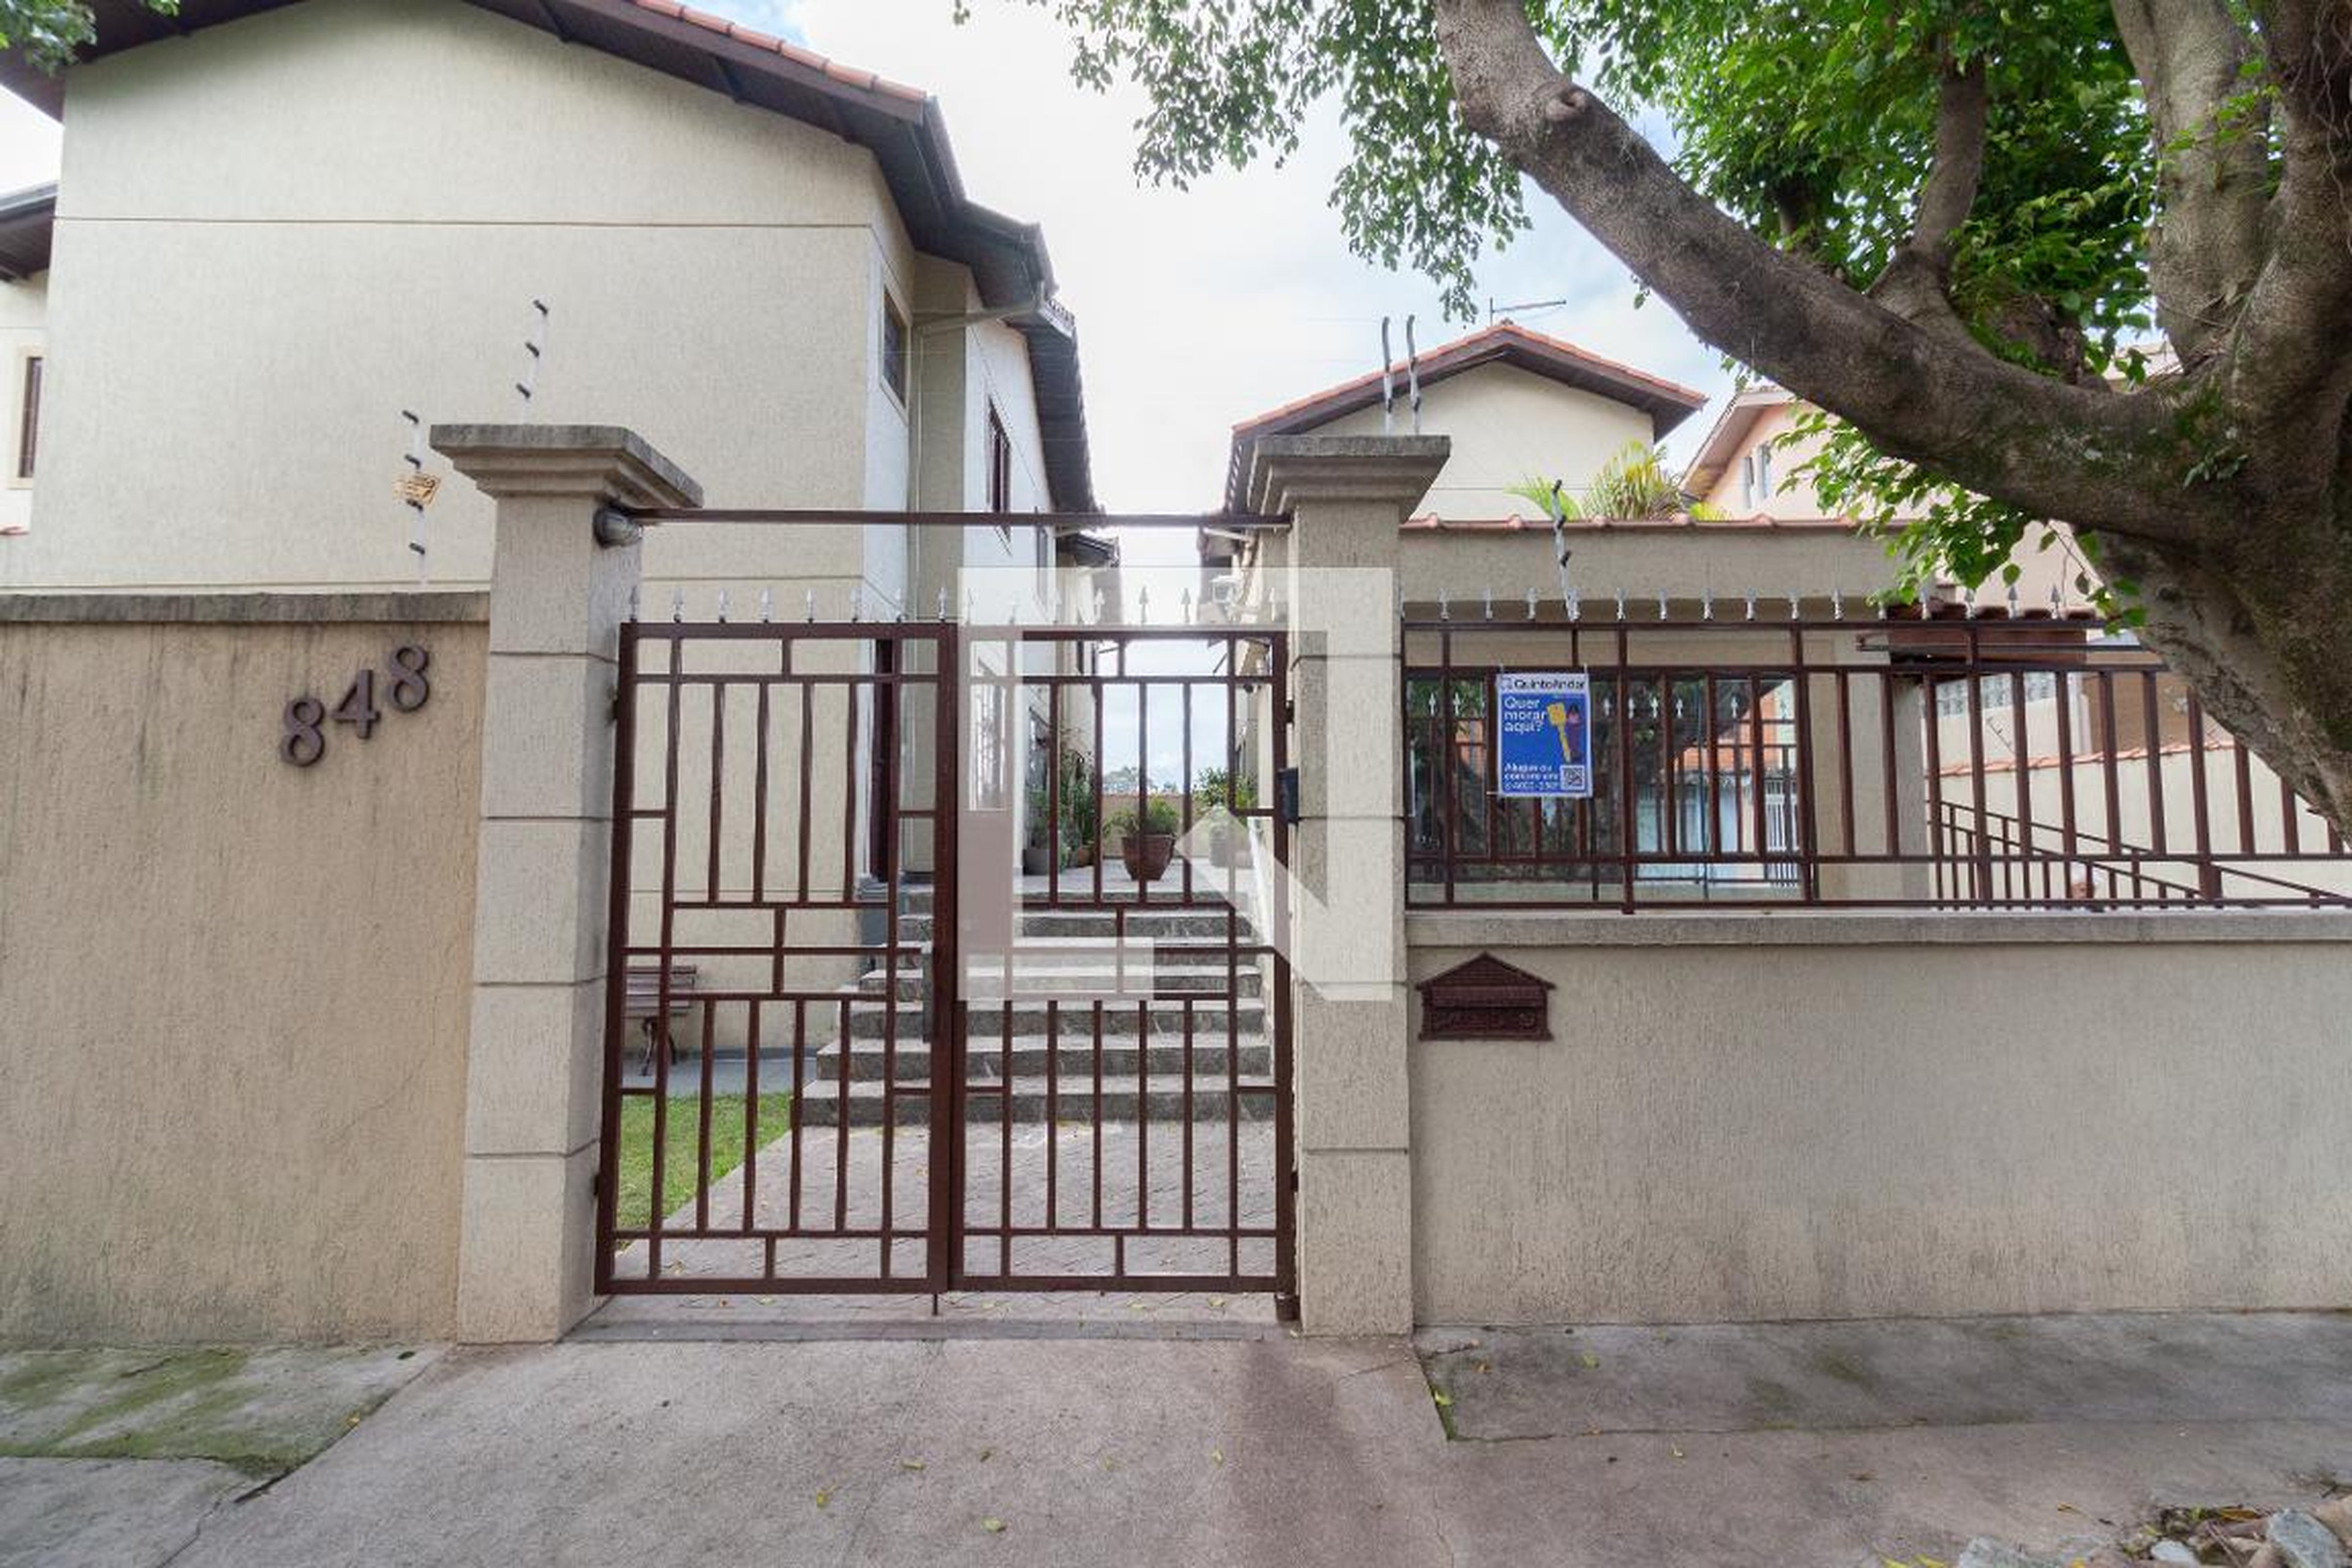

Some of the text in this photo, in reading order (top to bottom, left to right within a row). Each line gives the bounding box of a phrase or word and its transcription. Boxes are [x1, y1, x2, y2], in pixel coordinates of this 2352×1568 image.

[281, 644, 429, 766] 848
[1504, 696, 1540, 709] Quer
[1504, 711, 1547, 720] morar
[1504, 721, 1543, 734] aqui?
